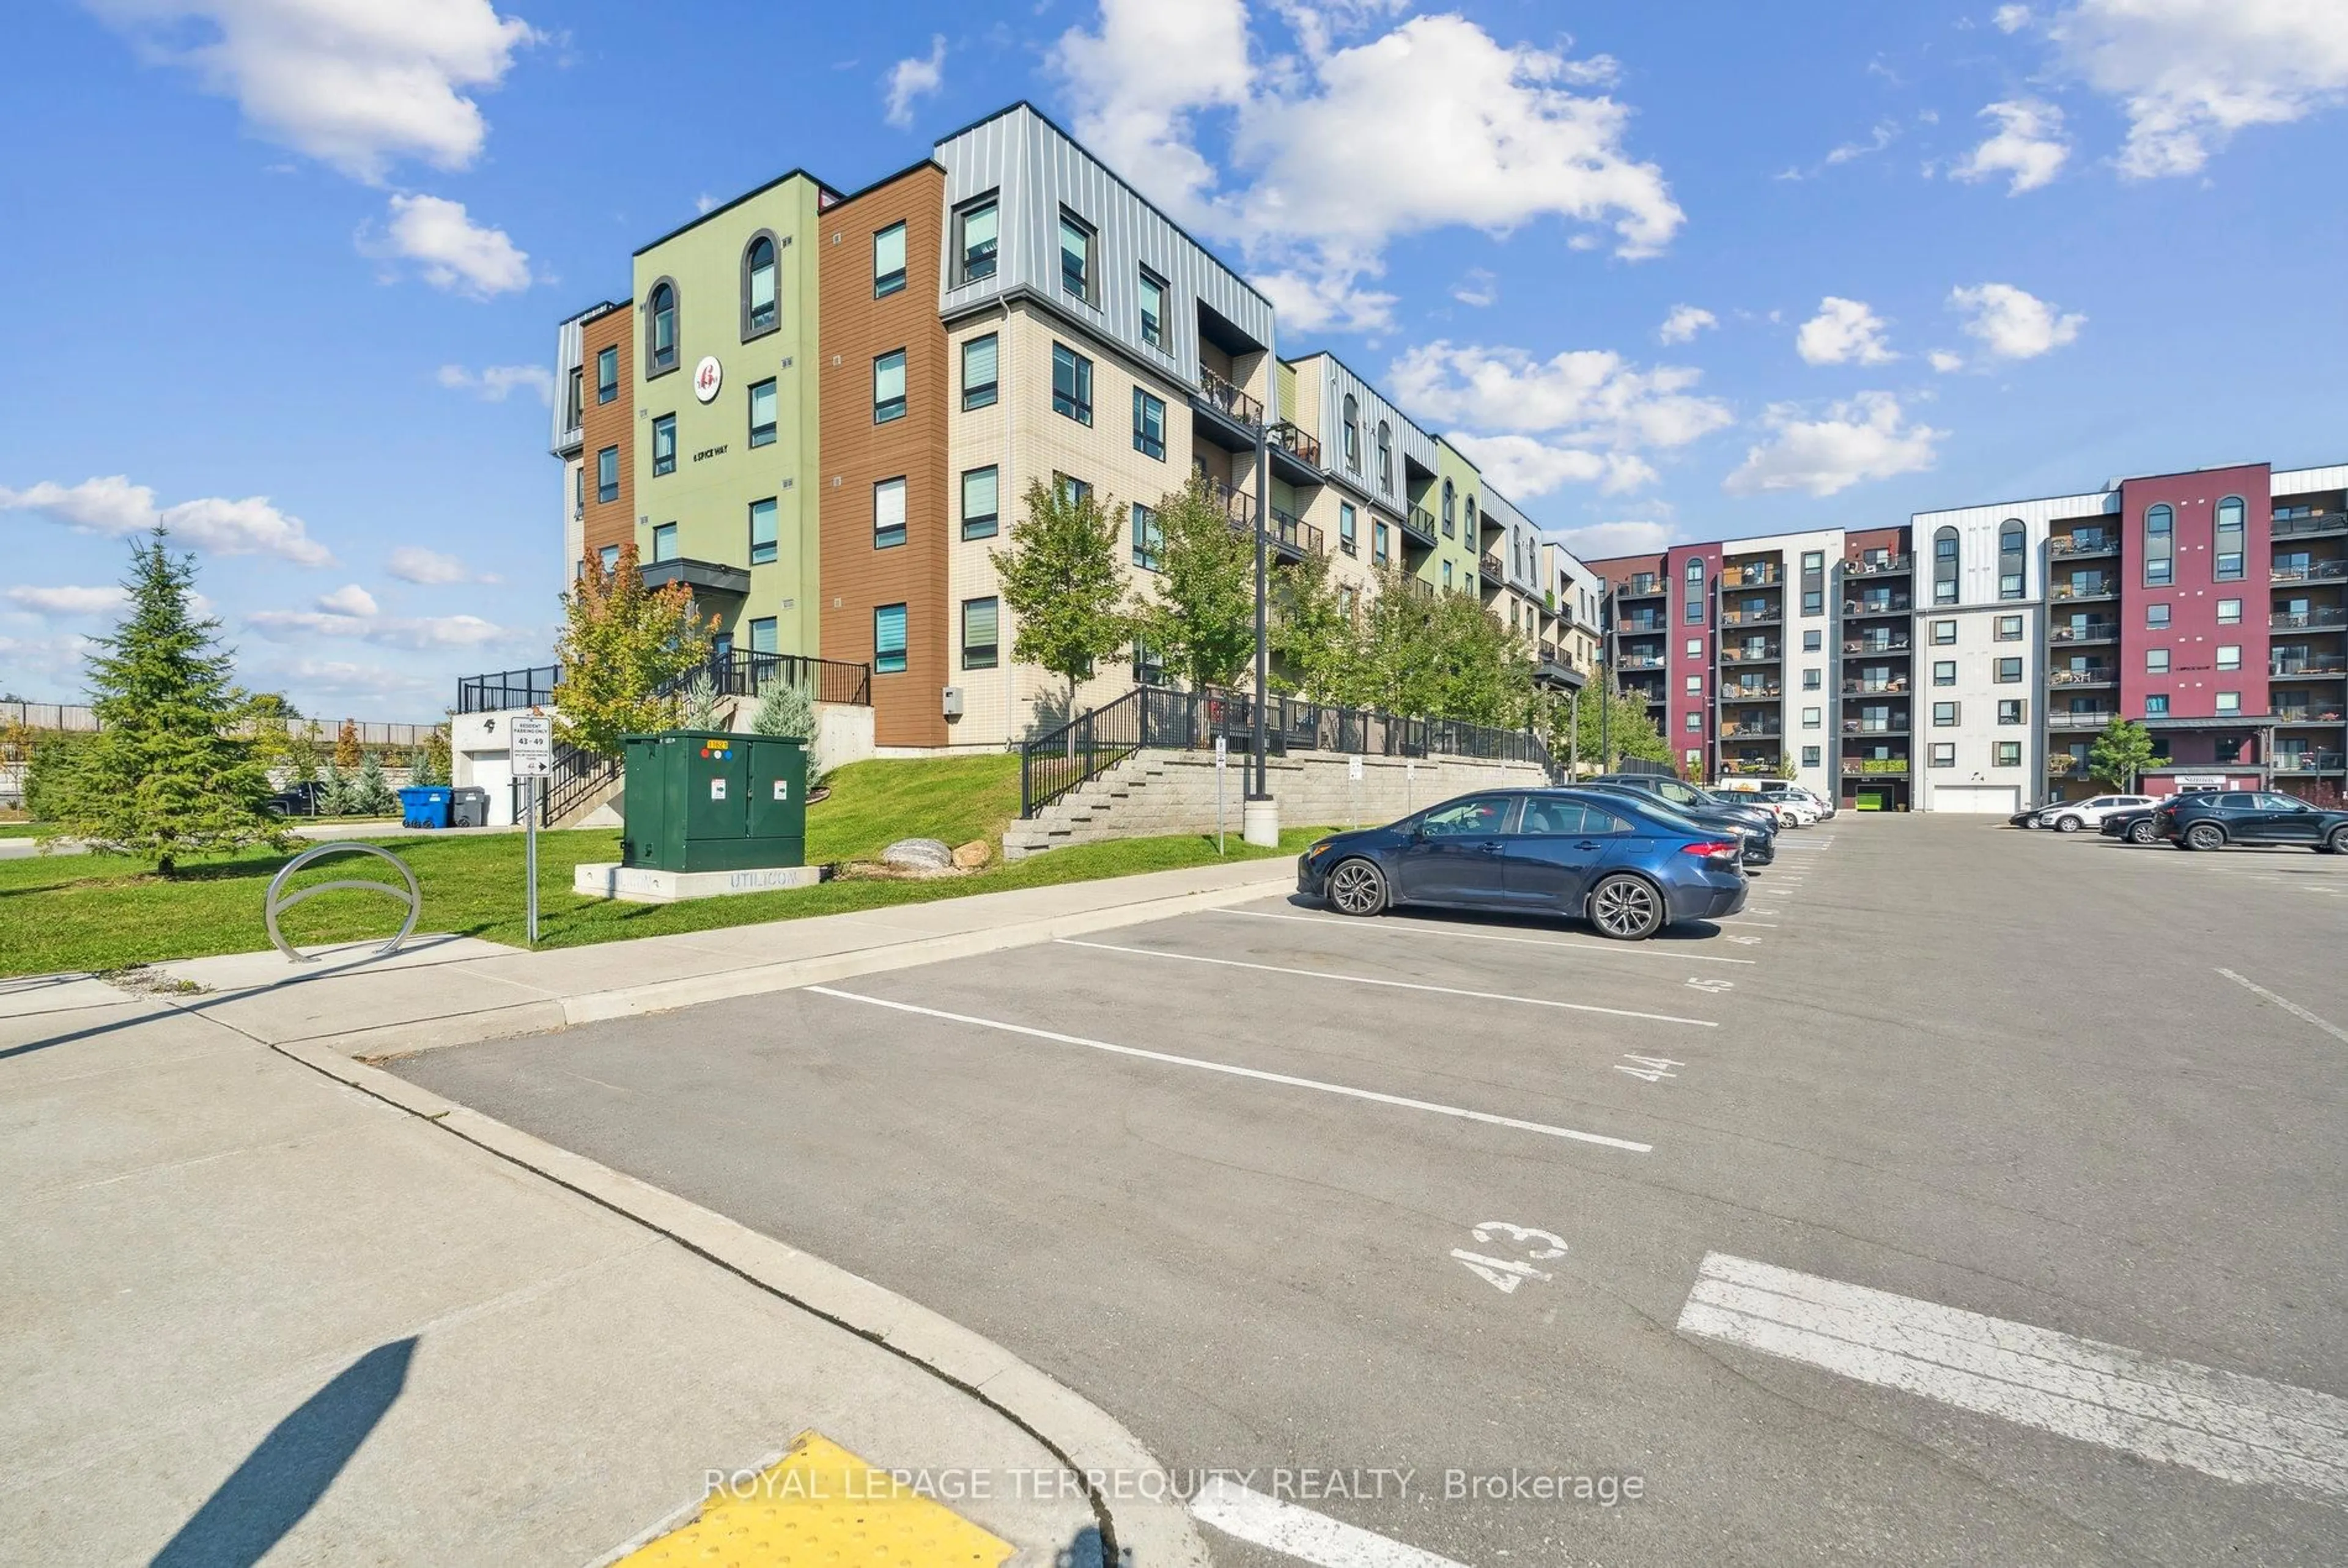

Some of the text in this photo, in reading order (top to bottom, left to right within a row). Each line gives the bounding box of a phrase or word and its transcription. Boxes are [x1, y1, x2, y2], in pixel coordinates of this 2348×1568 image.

[698, 449, 714, 462] SPICE
[714, 444, 728, 455] WAY
[730, 871, 797, 888] UTILICON
[1684, 977, 1735, 993] 45
[1614, 1053, 1686, 1082] 44
[1450, 1221, 1570, 1294] 43
